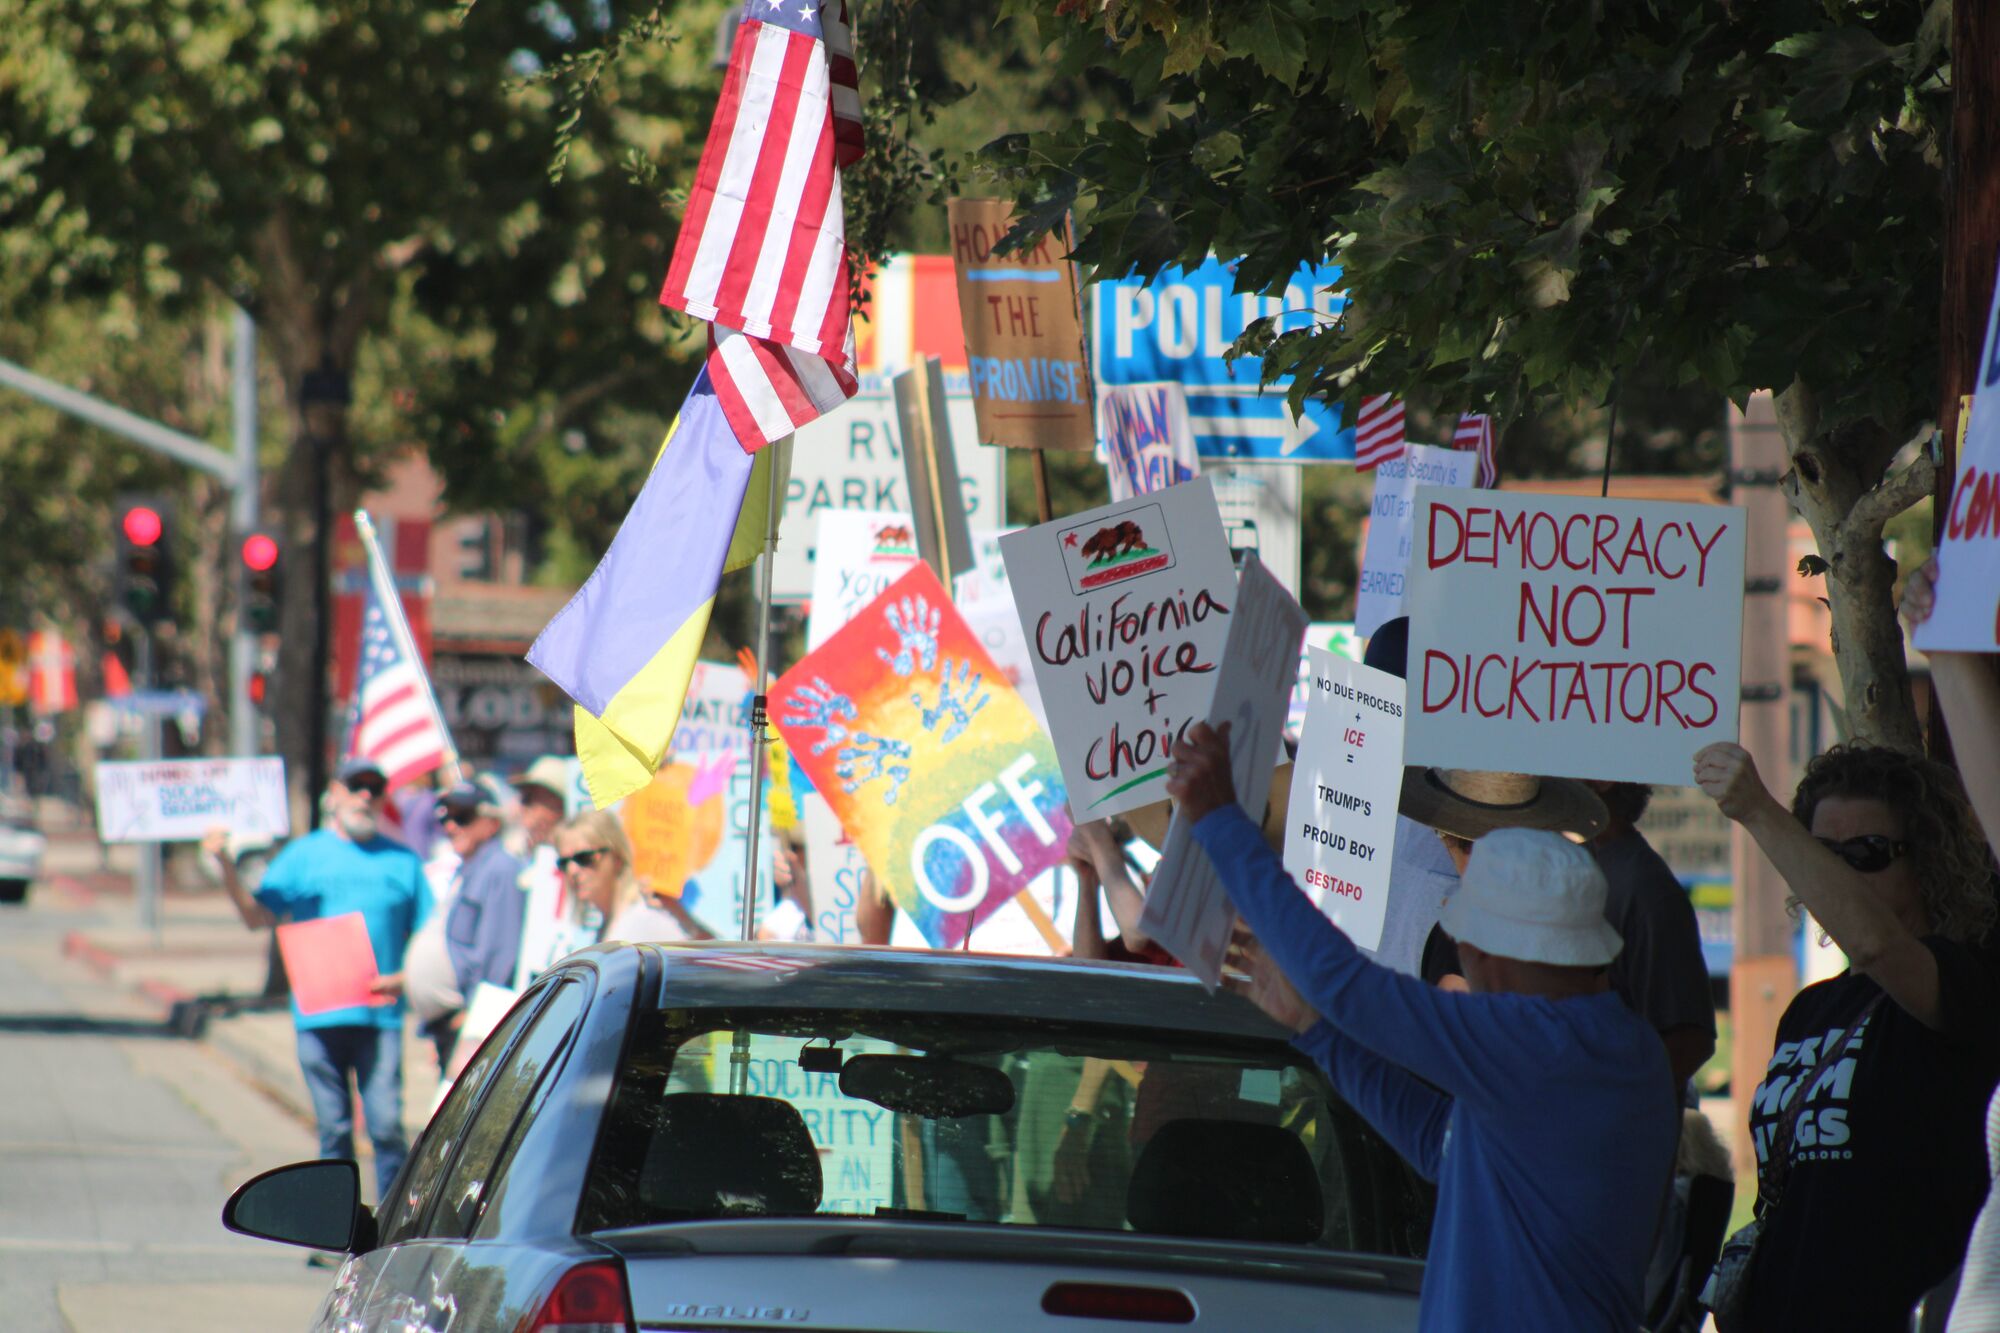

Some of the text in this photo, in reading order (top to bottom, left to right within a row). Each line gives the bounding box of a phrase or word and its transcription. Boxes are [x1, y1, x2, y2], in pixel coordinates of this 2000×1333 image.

[987, 295, 1044, 338] THE
[969, 355, 1087, 406] PROMISE
[1409, 456, 1448, 486] Security
[1448, 467, 1458, 485] is
[783, 476, 980, 517] PARKG
[1373, 494, 1397, 517] NOT
[1427, 501, 1728, 588] DEMOCRACY
[1360, 570, 1405, 596] EARNED
[1517, 582, 1656, 650] NOT
[1316, 676, 1403, 718] NO DUE PROCESS
[1422, 648, 1719, 730] DICKTATORS
[1343, 727, 1366, 748] ICE
[1318, 784, 1372, 817] TRUMP'S
[911, 752, 1058, 913] OFF
[1302, 823, 1375, 862] PROUD BOY
[1305, 868, 1363, 902] GESTAPO
